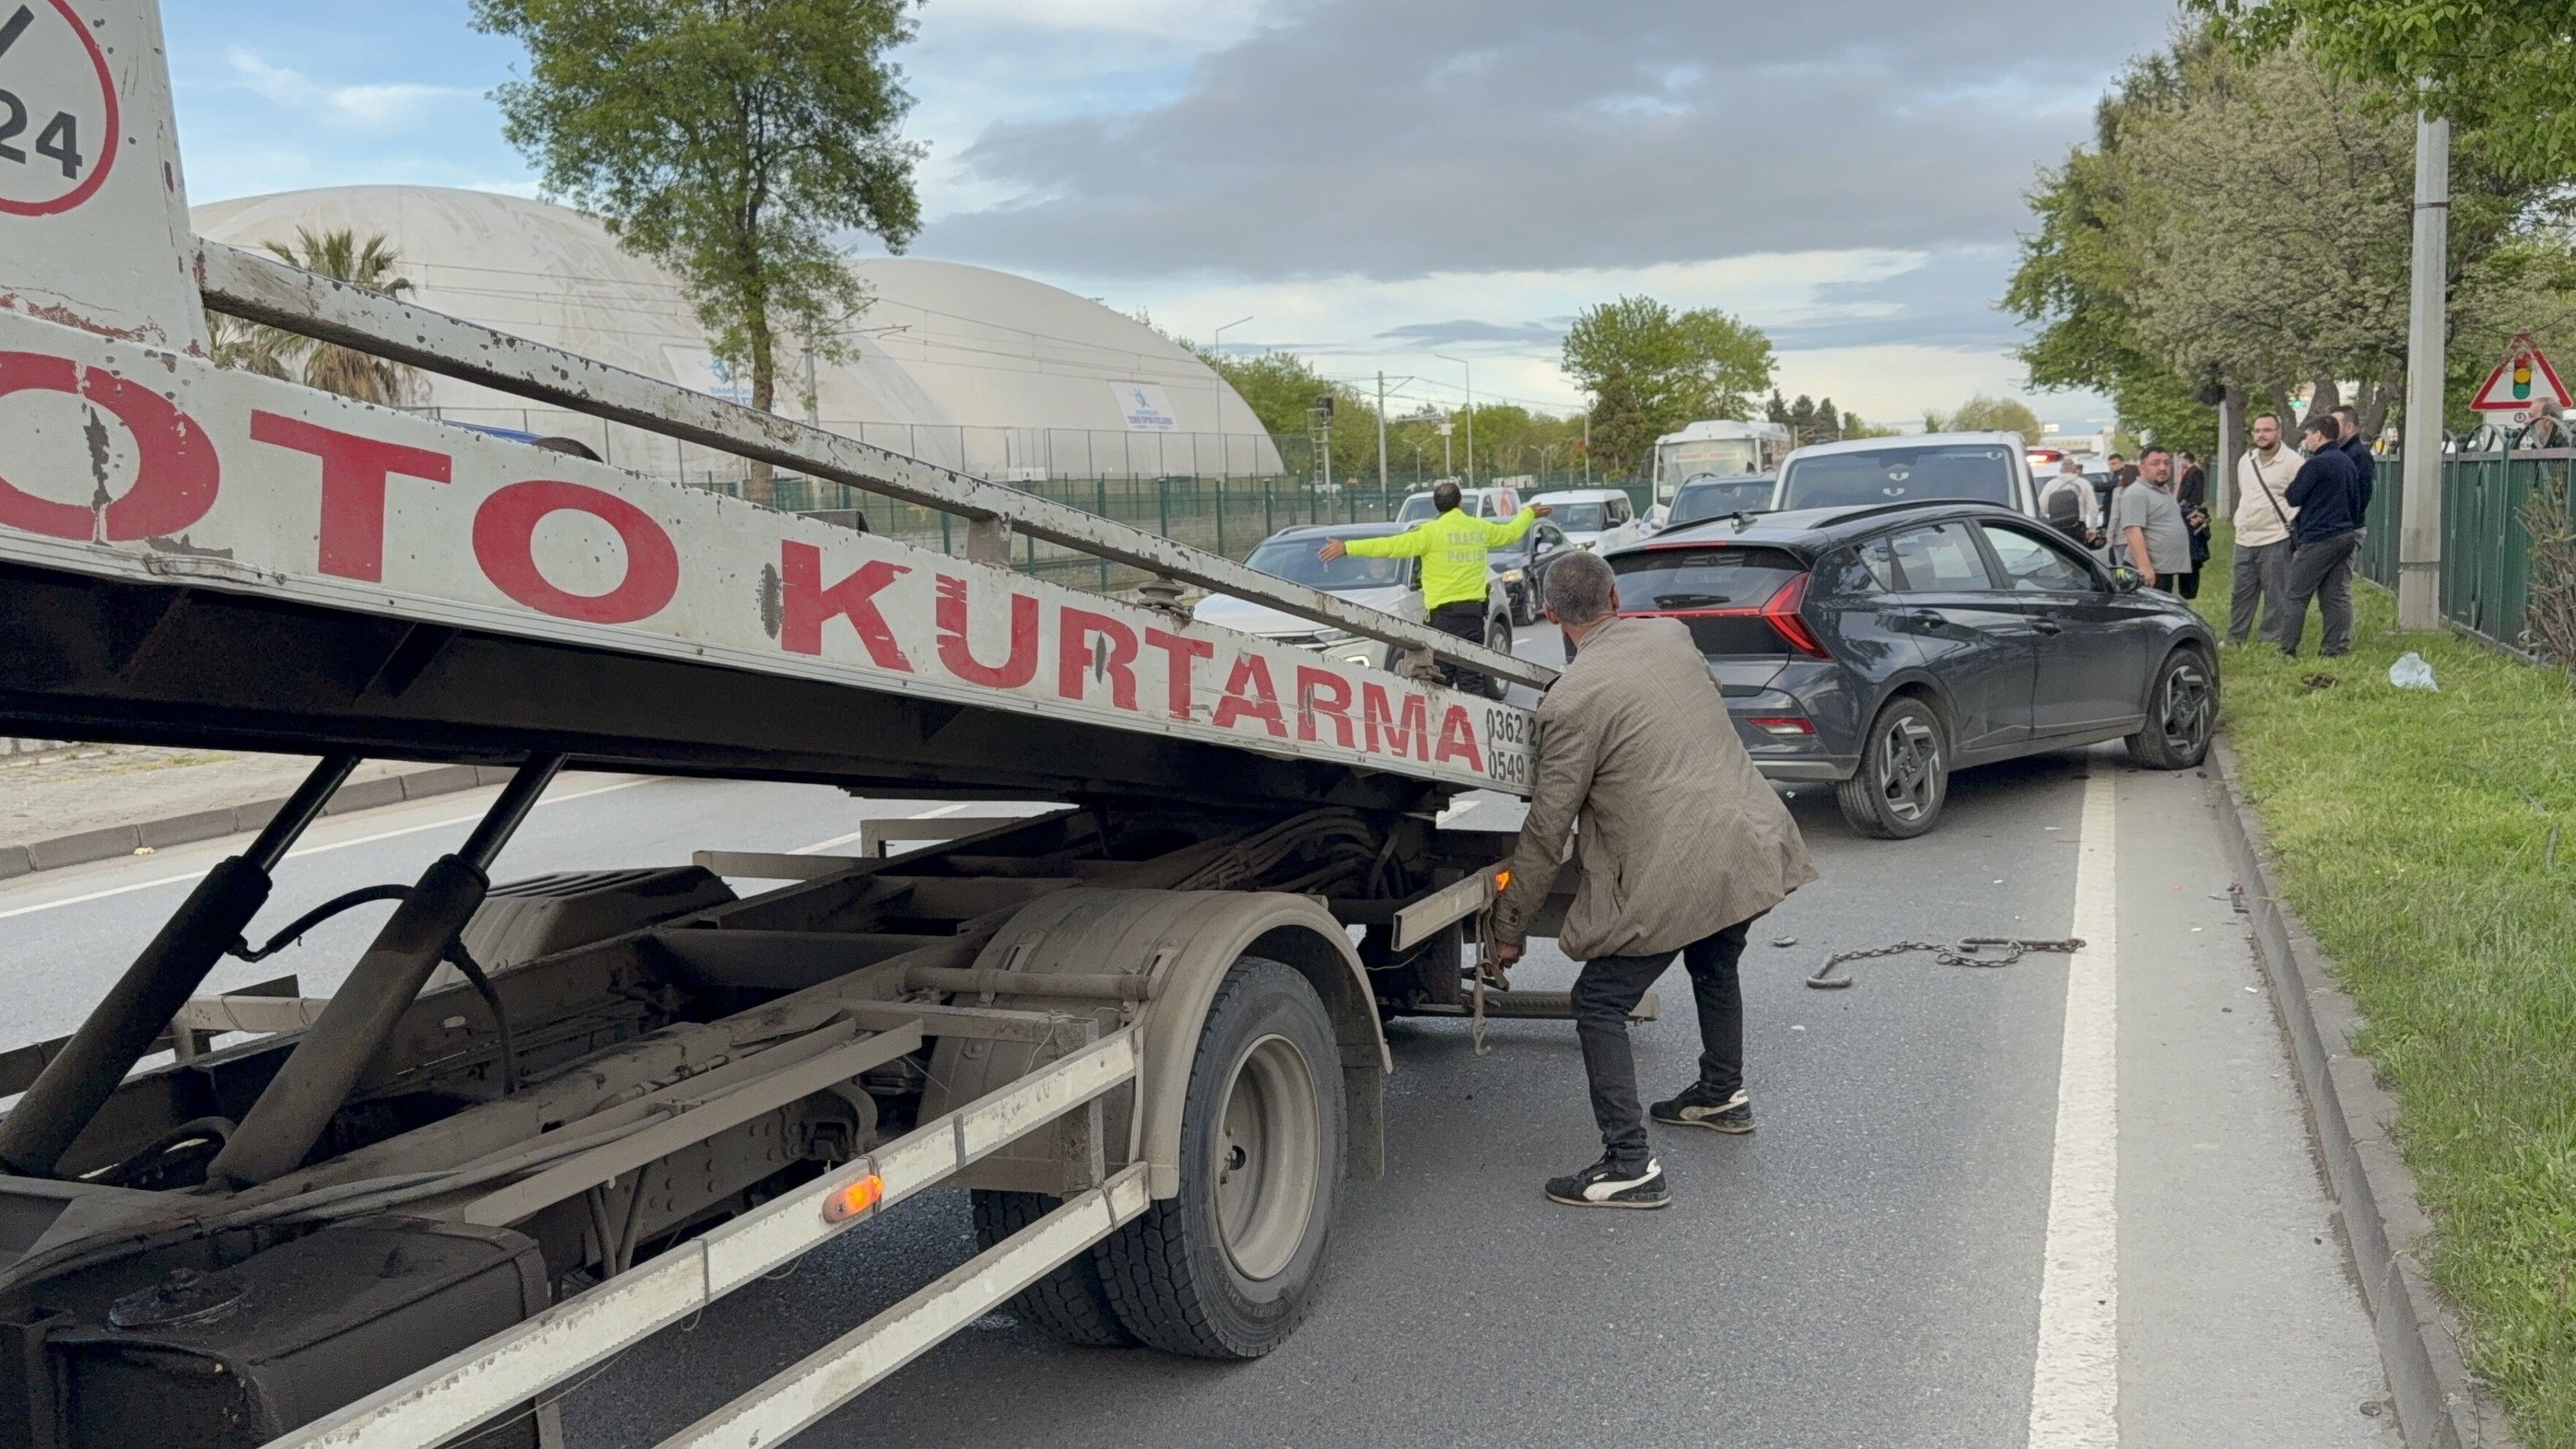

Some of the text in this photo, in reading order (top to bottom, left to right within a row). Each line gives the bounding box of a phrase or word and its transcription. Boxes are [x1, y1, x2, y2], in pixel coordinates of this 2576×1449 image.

[0, 351, 1484, 773] OTO KURTARMA
[1486, 708, 1523, 744] 0362
[1489, 751, 1524, 784] 0549
